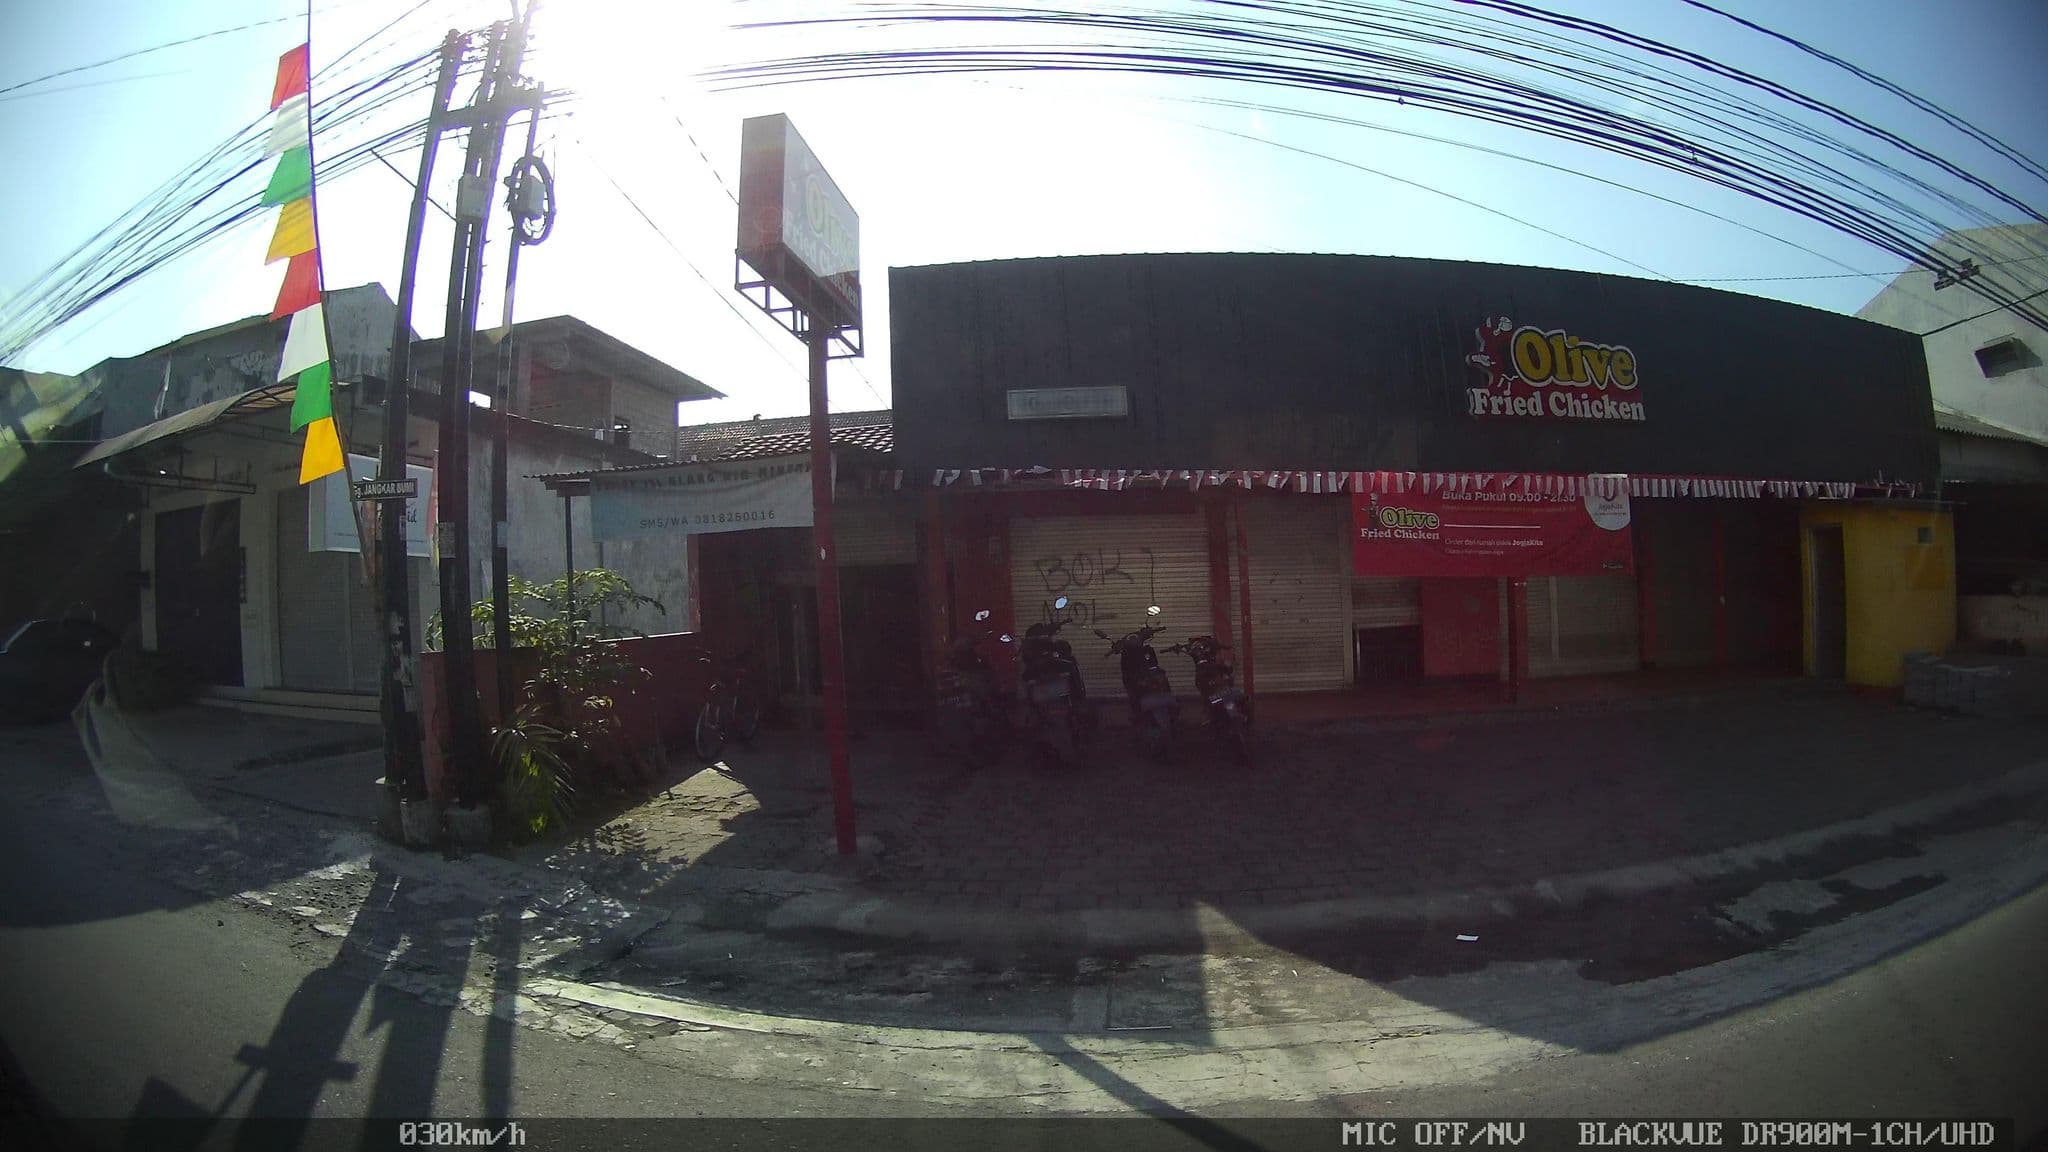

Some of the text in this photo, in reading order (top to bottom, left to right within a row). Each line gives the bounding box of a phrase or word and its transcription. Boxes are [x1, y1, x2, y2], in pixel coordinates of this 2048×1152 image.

[1513, 327, 1637, 389] Olive
[1471, 388, 1646, 420] Fried Chicken
[364, 483, 395, 495] JANGKAR
[639, 516, 689, 529] SMS/WA
[1380, 507, 1439, 529] Olive
[1361, 528, 1440, 541] Fried Chicken
